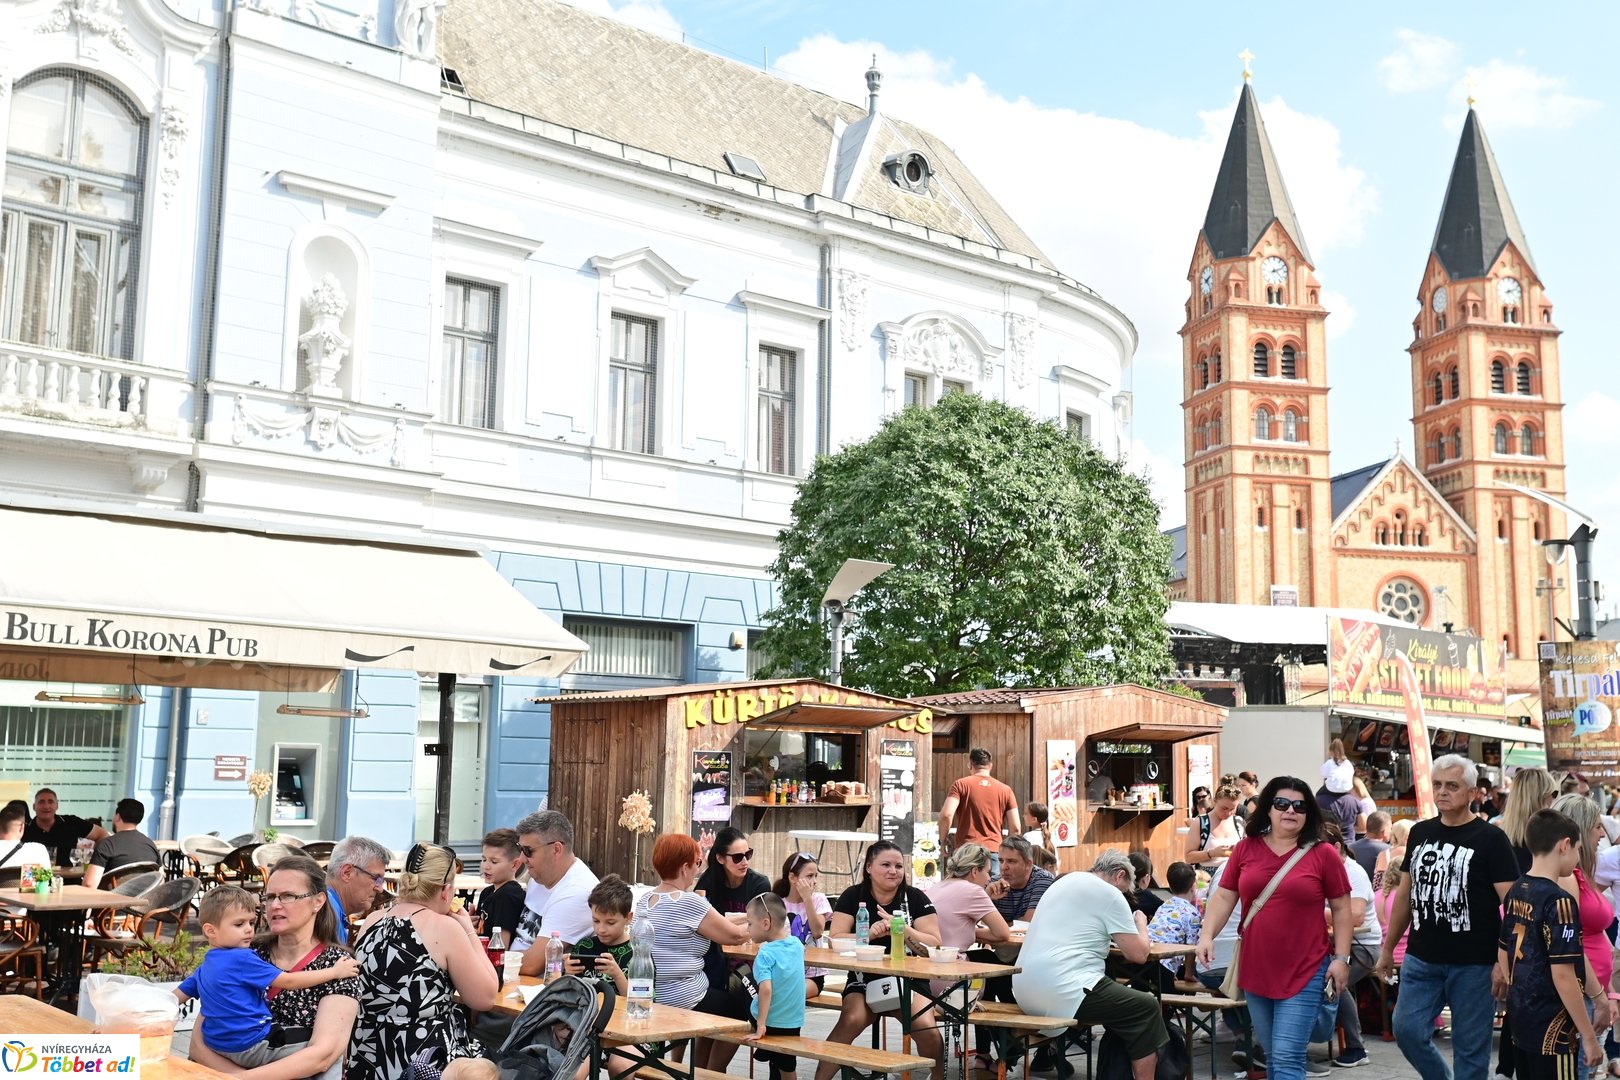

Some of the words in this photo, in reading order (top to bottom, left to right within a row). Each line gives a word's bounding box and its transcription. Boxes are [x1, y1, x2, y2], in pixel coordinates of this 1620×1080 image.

[3, 611, 80, 646] BULL
[84, 618, 202, 655] KORONA
[205, 627, 259, 658] PUB
[1407, 638, 1439, 665] Királyi
[1379, 659, 1432, 693] STET
[1435, 664, 1471, 697] FOOD
[1549, 668, 1620, 701] Tirpá
[1561, 924, 1575, 943] hp
